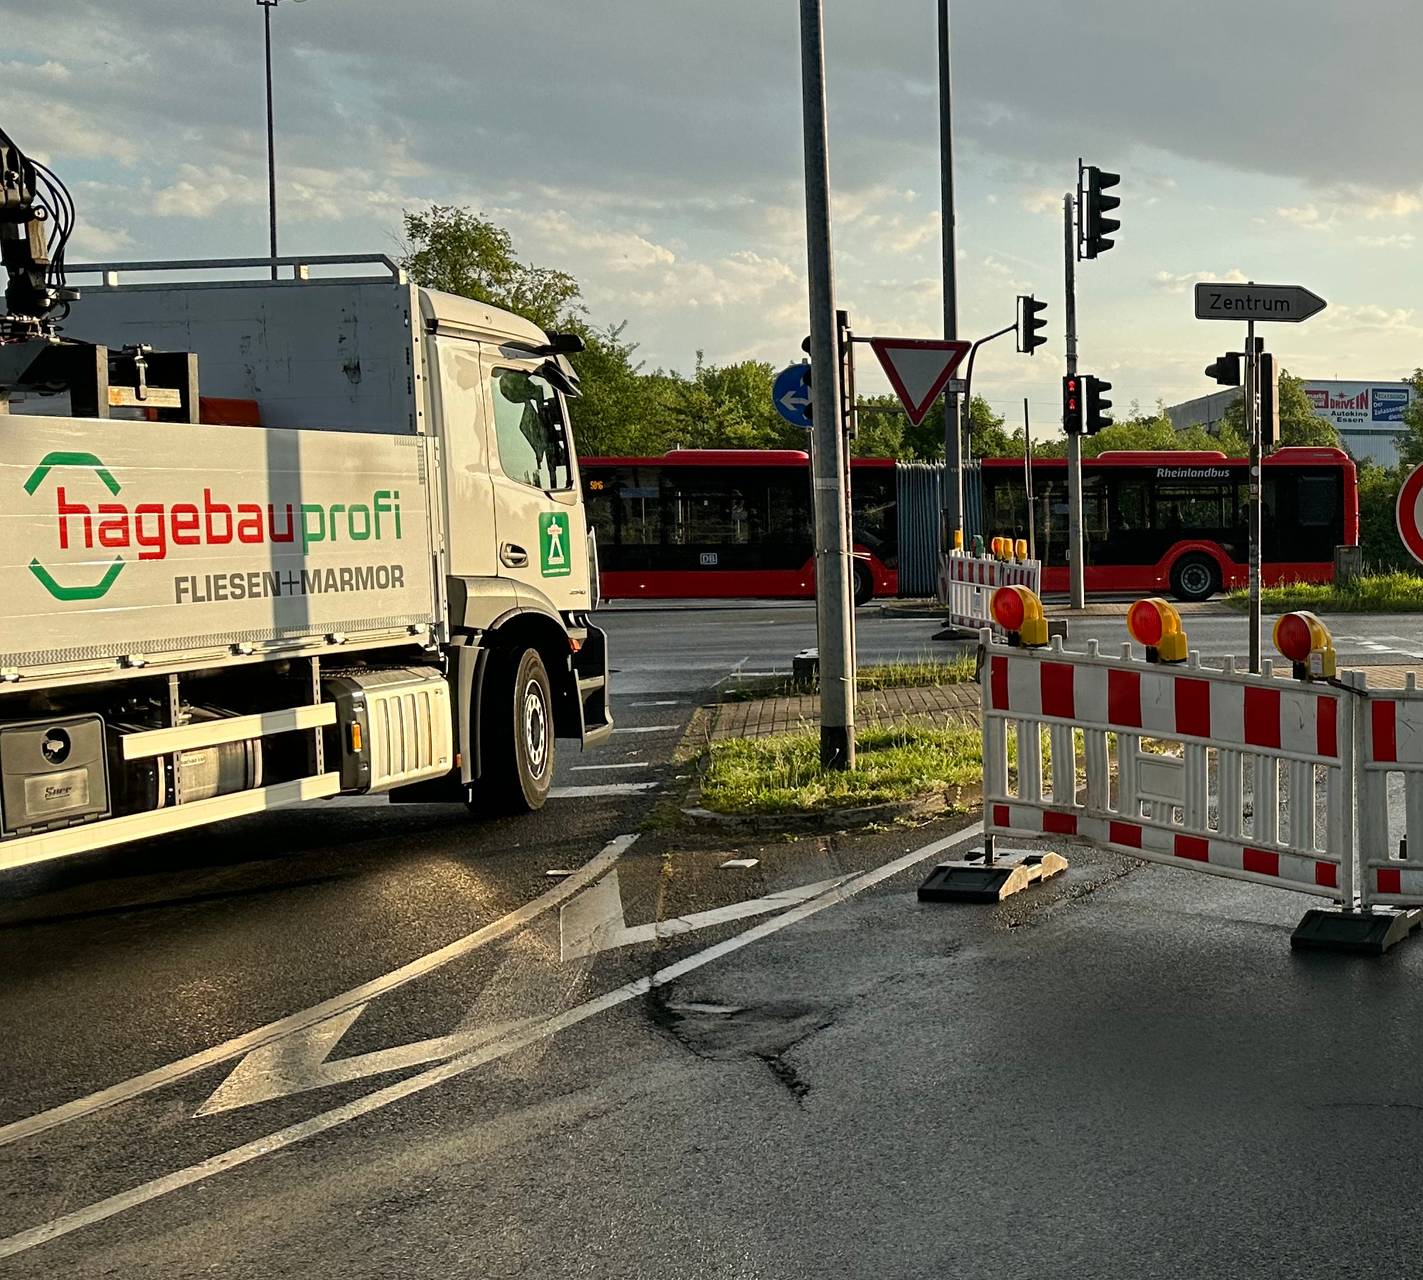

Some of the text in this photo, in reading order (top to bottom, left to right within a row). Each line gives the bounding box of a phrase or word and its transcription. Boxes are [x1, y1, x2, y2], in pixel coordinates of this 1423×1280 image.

[1209, 293, 1290, 312] Zentrum
[1156, 468, 1230, 478] Rheinlandbus
[56, 487, 402, 560] hagebauprofi
[701, 554, 717, 564] DB
[174, 564, 405, 604] FLIESEN+MARMOR
